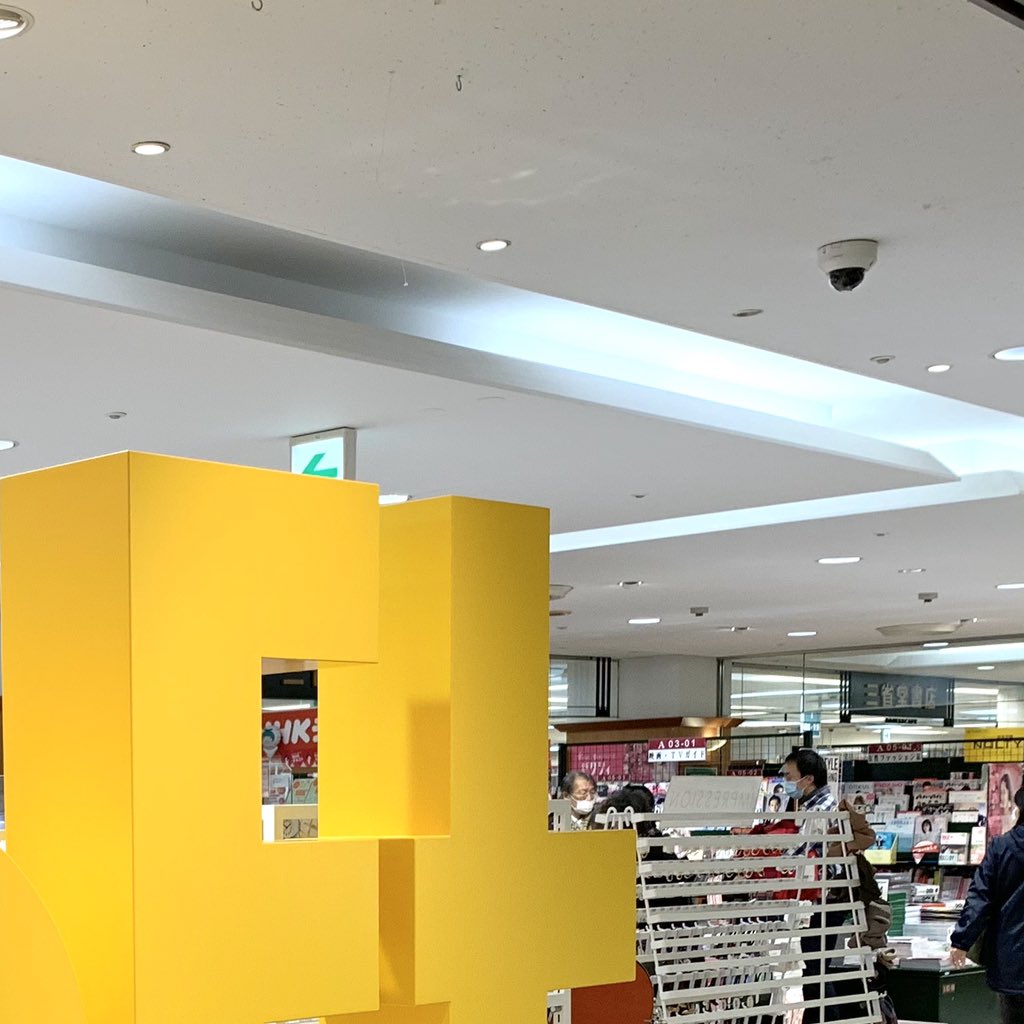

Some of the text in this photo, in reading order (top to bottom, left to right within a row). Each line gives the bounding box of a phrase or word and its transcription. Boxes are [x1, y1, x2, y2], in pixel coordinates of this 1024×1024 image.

[864, 683, 937, 709] 三省堂書店
[658, 739, 696, 749] A 03-01
